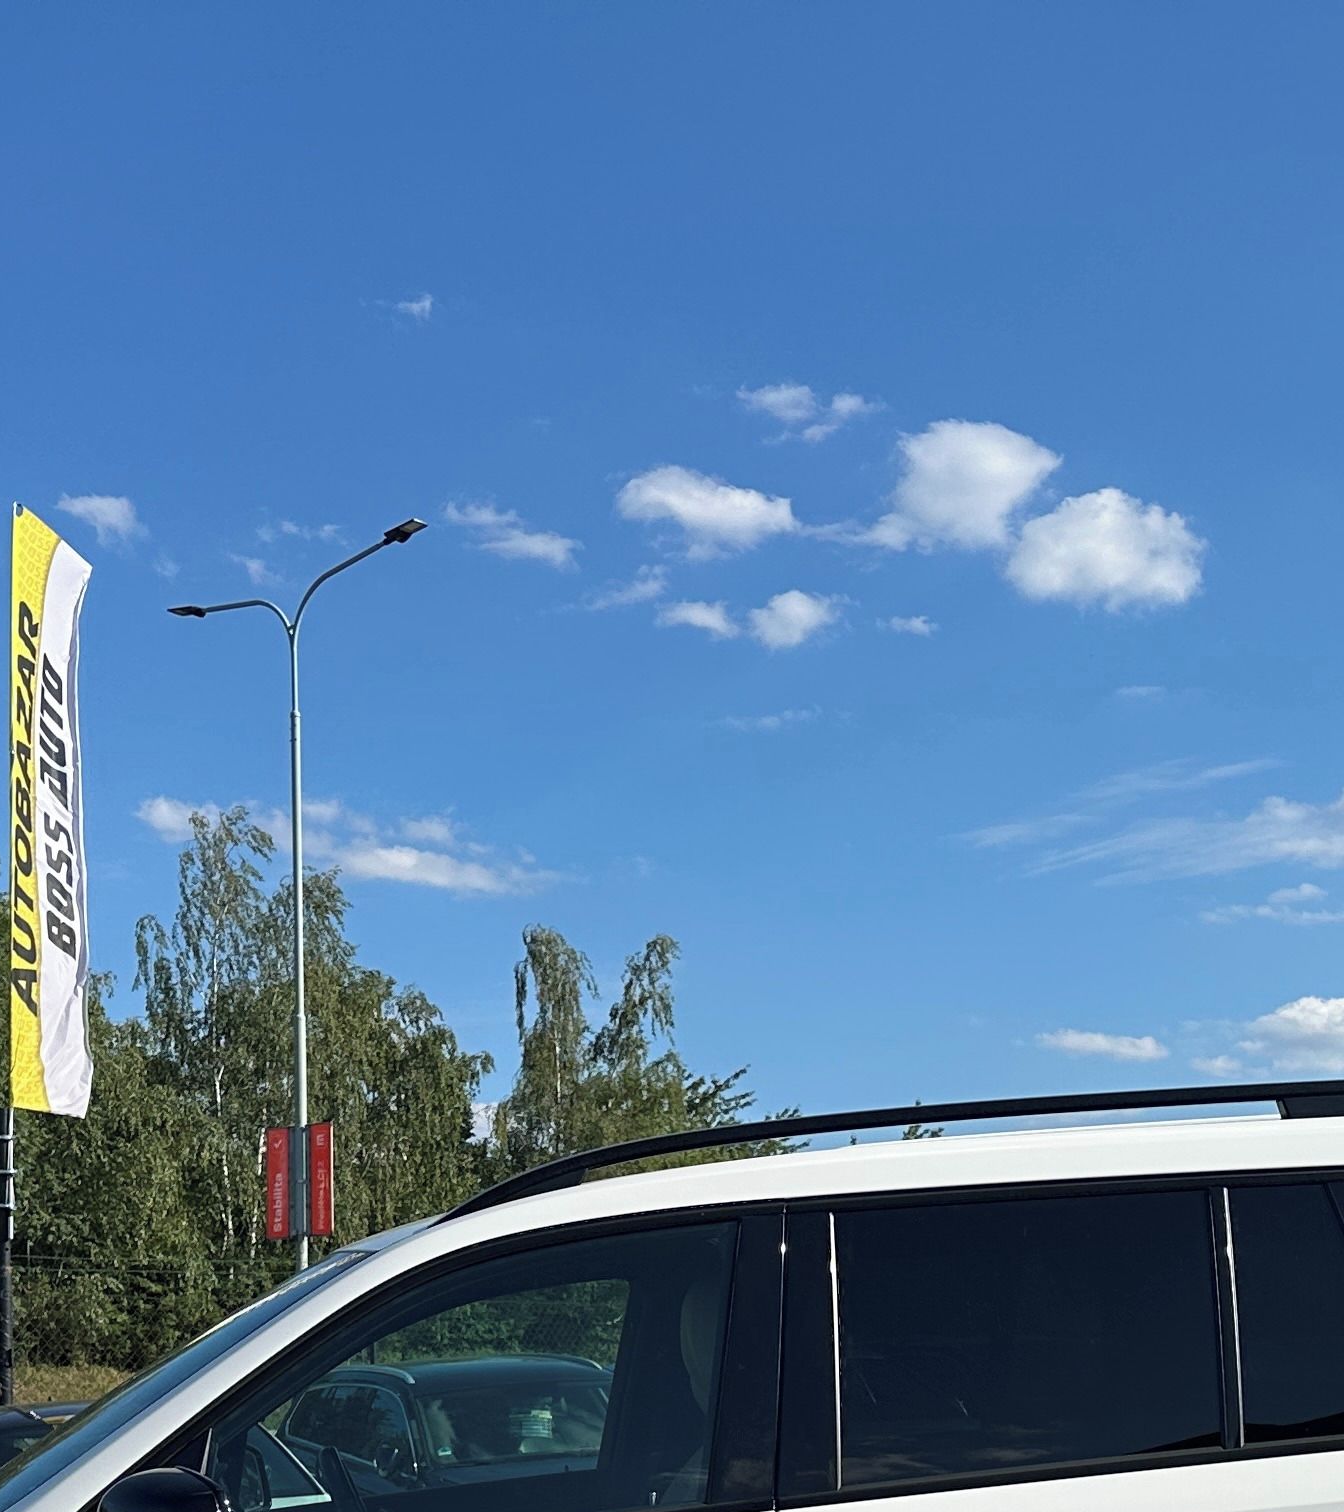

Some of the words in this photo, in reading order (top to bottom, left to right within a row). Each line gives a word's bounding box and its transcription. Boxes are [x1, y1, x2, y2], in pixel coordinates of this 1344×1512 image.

[11, 601, 40, 1017] AUTOBAZAR
[39, 652, 69, 812] AUTO
[44, 811, 76, 961] BOSS
